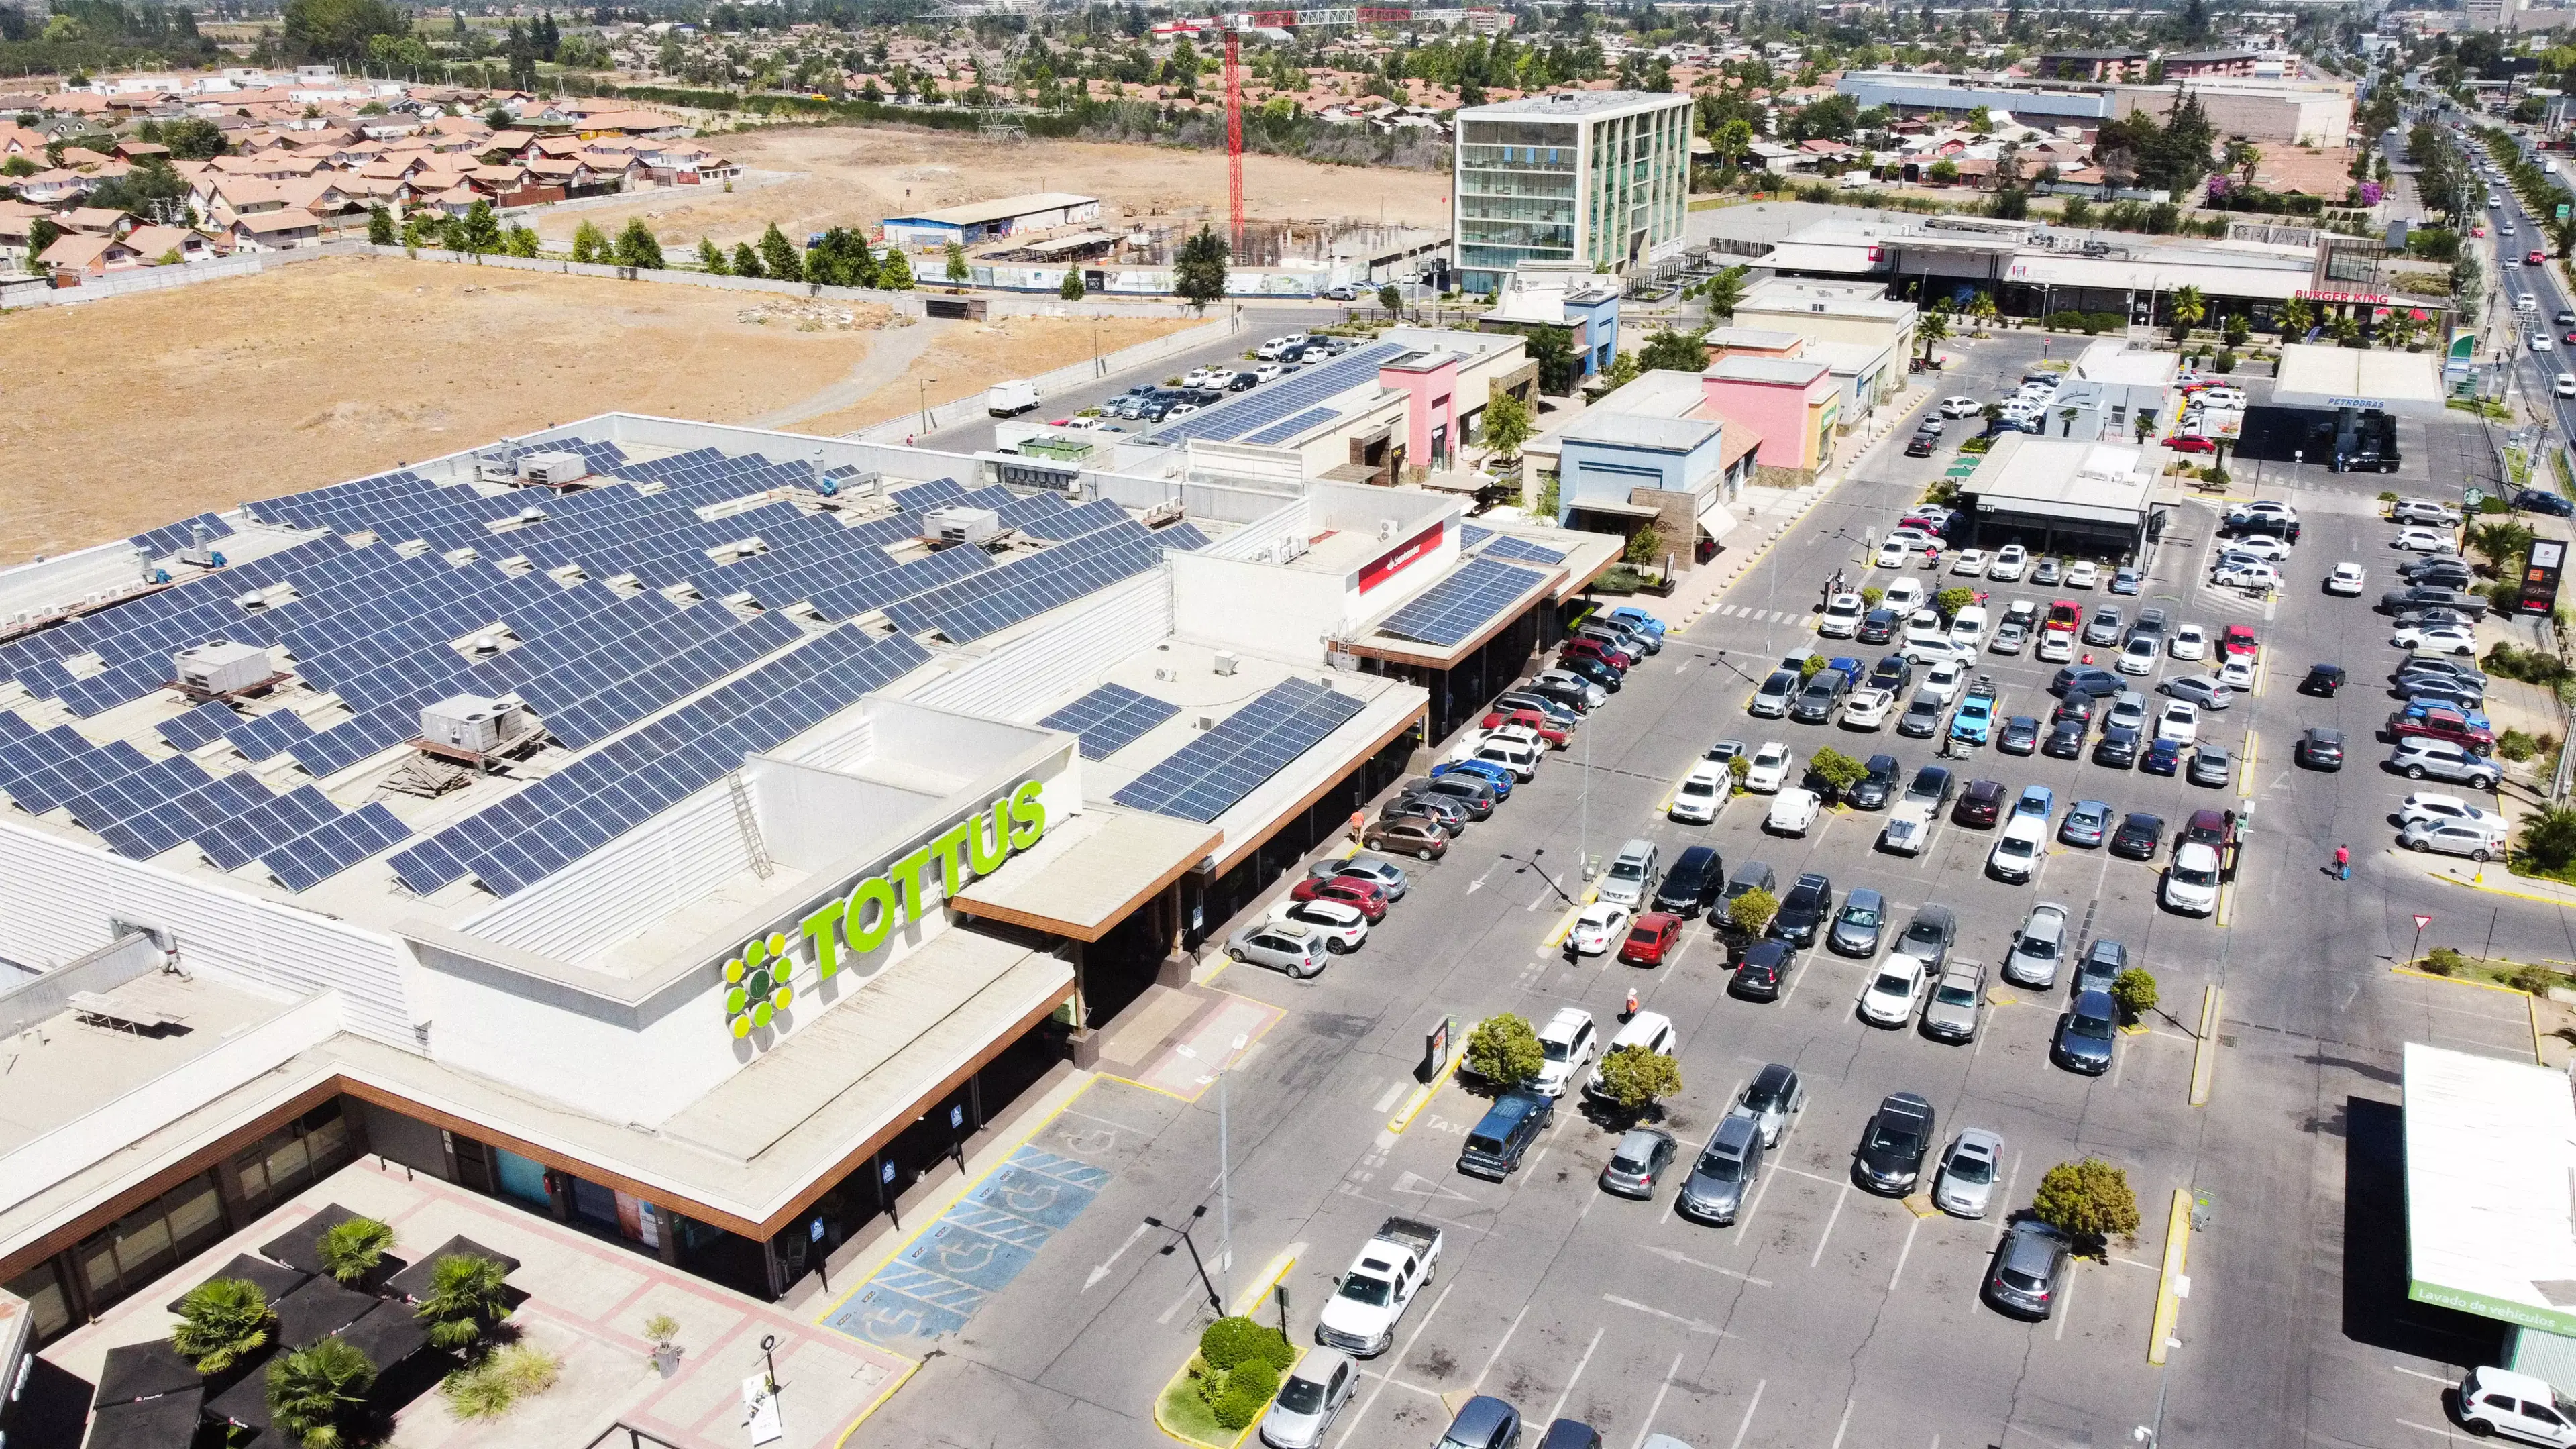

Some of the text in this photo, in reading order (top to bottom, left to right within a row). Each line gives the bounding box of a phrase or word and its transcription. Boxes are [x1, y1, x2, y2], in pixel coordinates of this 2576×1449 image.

[2295, 290, 2389, 303] BURGER KING
[2328, 398, 2385, 408] PETROBRAS
[1394, 543, 1421, 567] Santander
[798, 780, 1045, 981] TOTTUS
[1427, 1114, 1472, 1136] TAXI
[1465, 1154, 1501, 1166] CHEVROLET
[2418, 1288, 2467, 1307] Lavado
[2469, 1301, 2487, 1312] de
